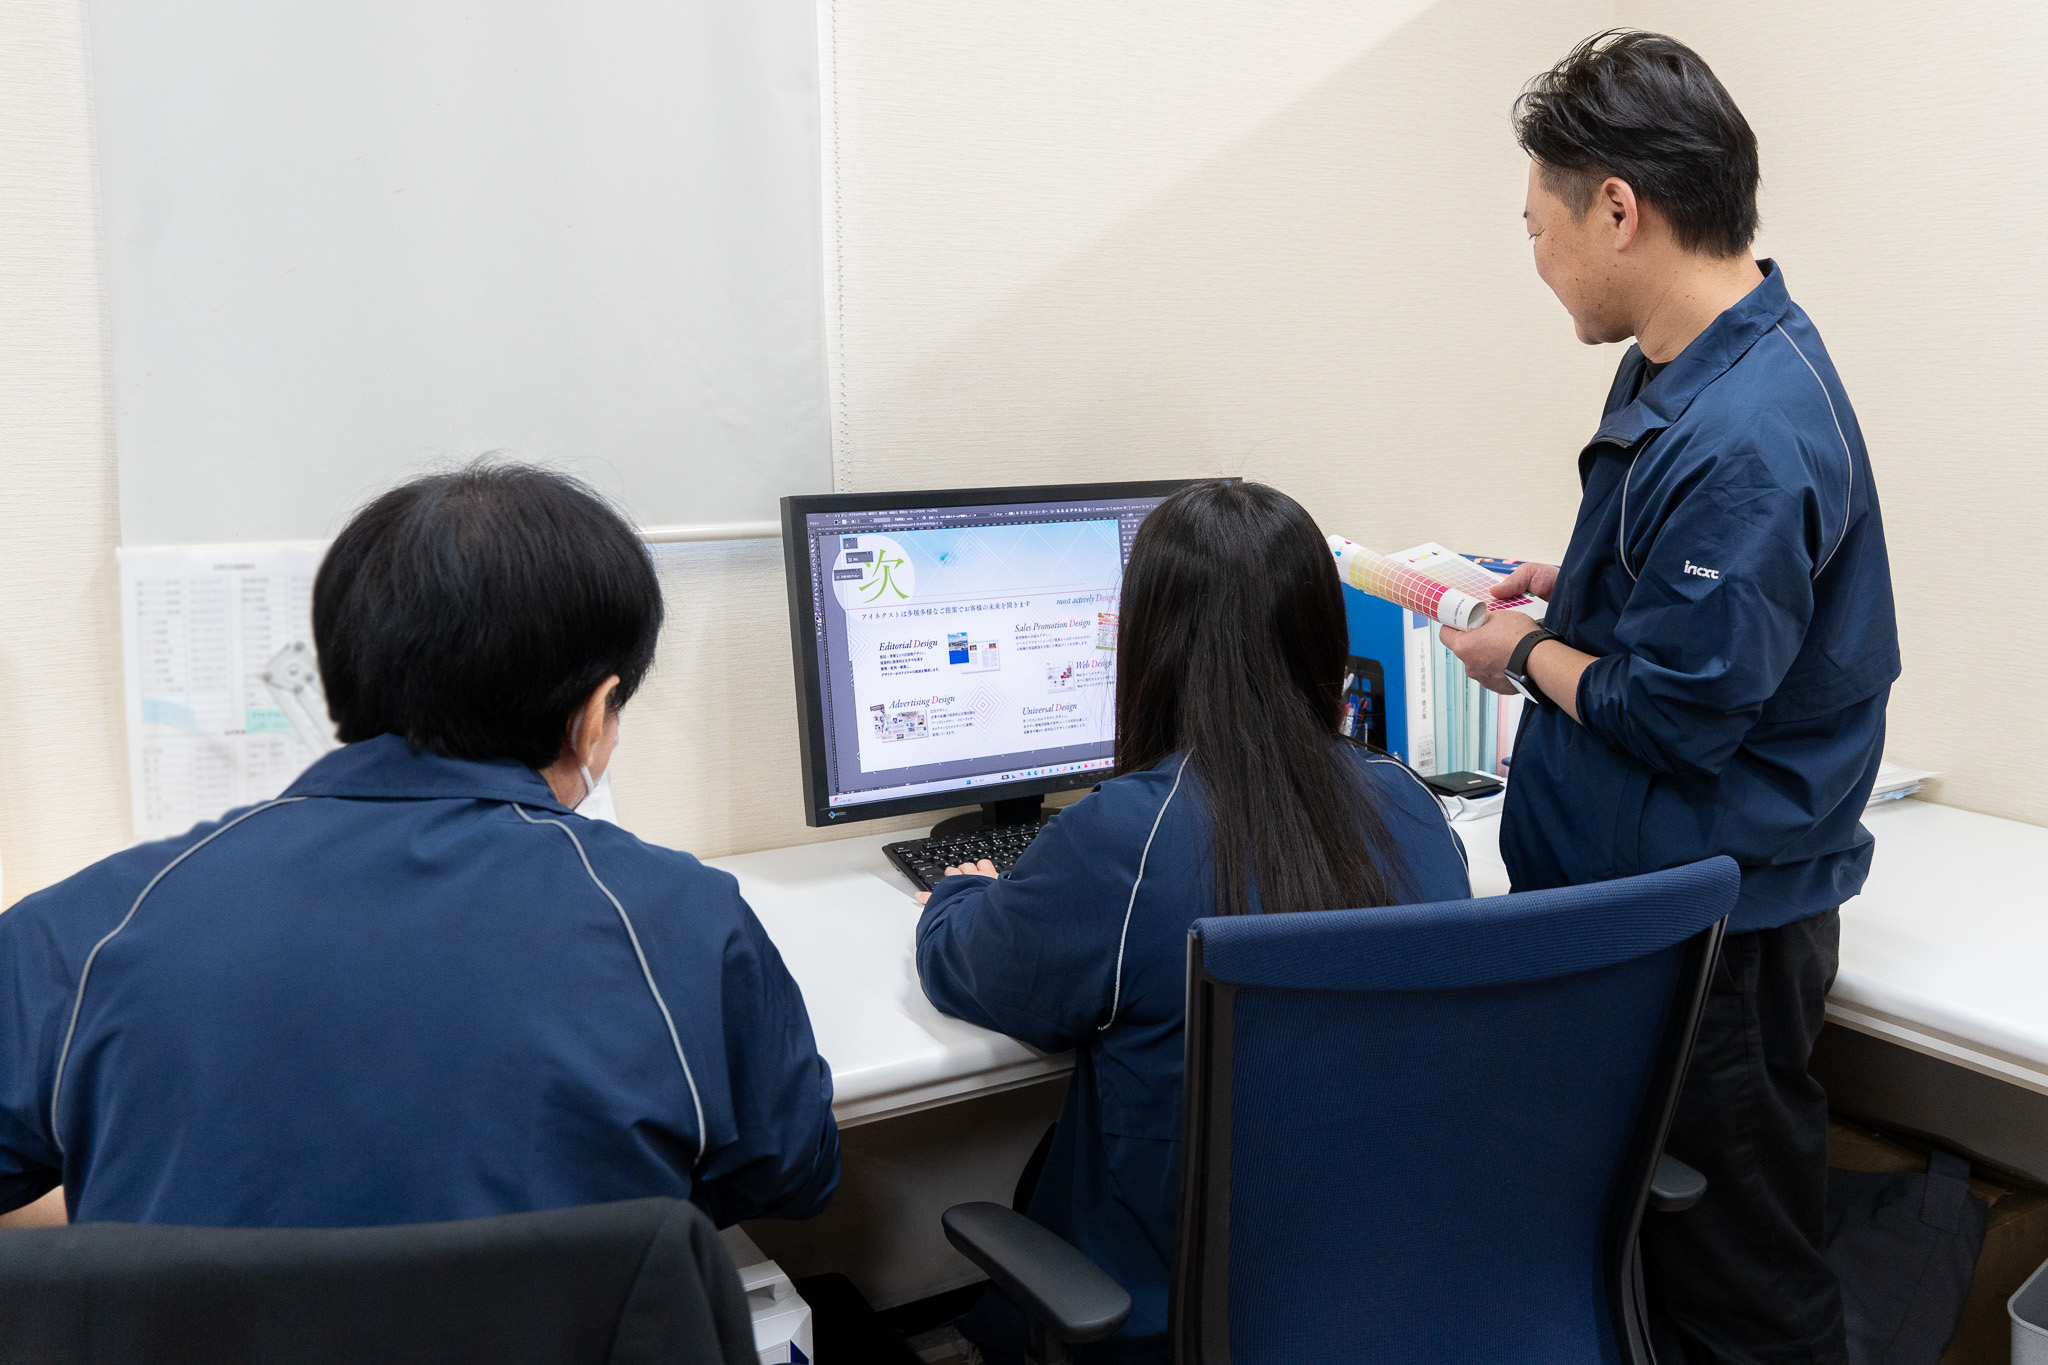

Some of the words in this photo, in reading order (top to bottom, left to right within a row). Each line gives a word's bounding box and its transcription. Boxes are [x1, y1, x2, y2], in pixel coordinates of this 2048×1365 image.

[858, 548, 909, 604] 次
[1095, 594, 1116, 603] Design
[1015, 623, 1032, 633] Sales
[1033, 620, 1068, 632] Promotion
[1069, 619, 1091, 630] Design
[879, 640, 912, 651] Editorial
[913, 639, 938, 649] Design
[1076, 660, 1090, 669] Web
[1091, 659, 1112, 671] Design
[888, 697, 930, 709] Advertising
[931, 695, 956, 705] Design
[1022, 703, 1054, 715] Universal
[1055, 702, 1078, 713] Design
